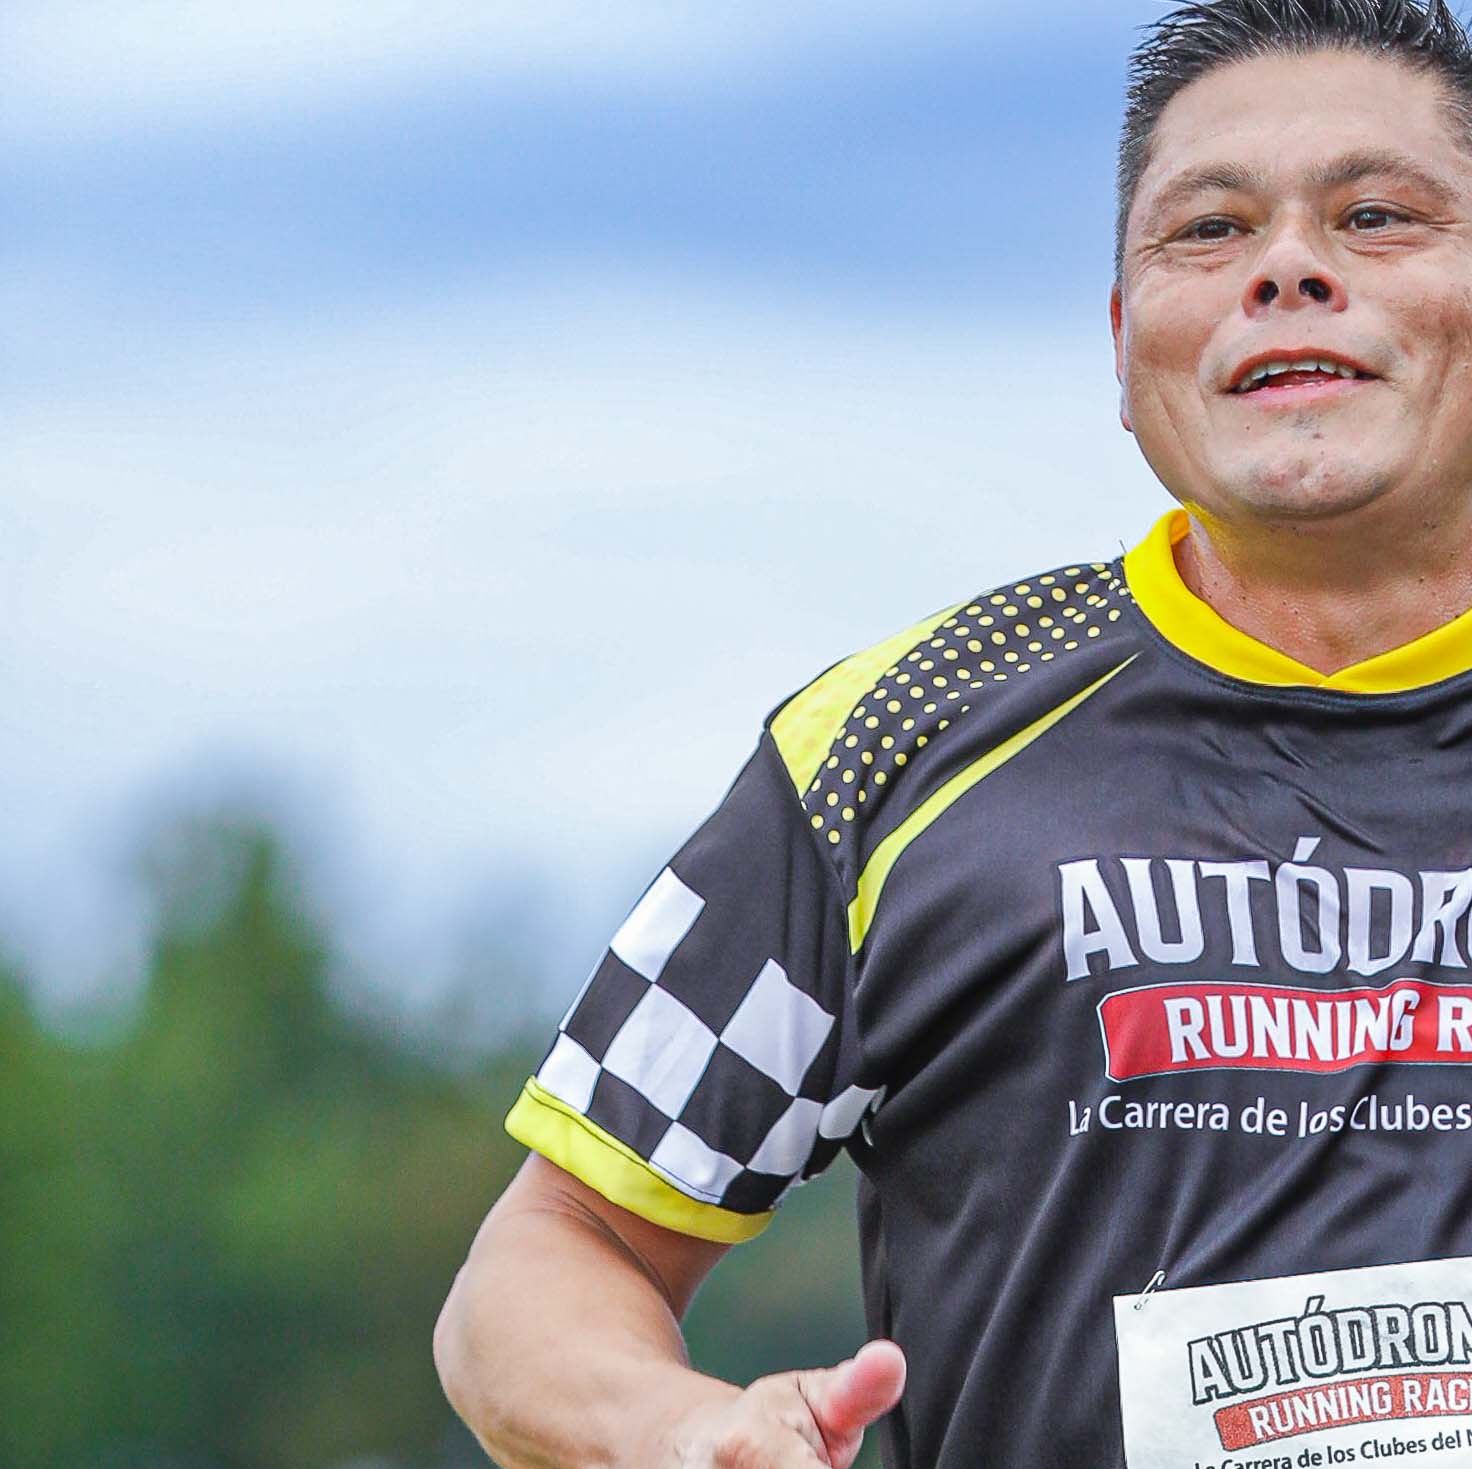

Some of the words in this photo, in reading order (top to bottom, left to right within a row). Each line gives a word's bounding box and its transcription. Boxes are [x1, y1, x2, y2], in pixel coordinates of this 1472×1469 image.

[1162, 989, 1419, 1064] RUNNING
[1068, 1100, 1091, 1136] La
[1098, 1095, 1230, 1131] Carrera
[1240, 1097, 1288, 1136] de
[1298, 1101, 1346, 1138] los
[1350, 1094, 1472, 1131] Clubes
[1247, 1380, 1393, 1440] RUNNING
[1297, 1448, 1323, 1469] de
[1327, 1444, 1356, 1465] los
[1360, 1437, 1428, 1460] Clubes
[1431, 1429, 1462, 1450] del
